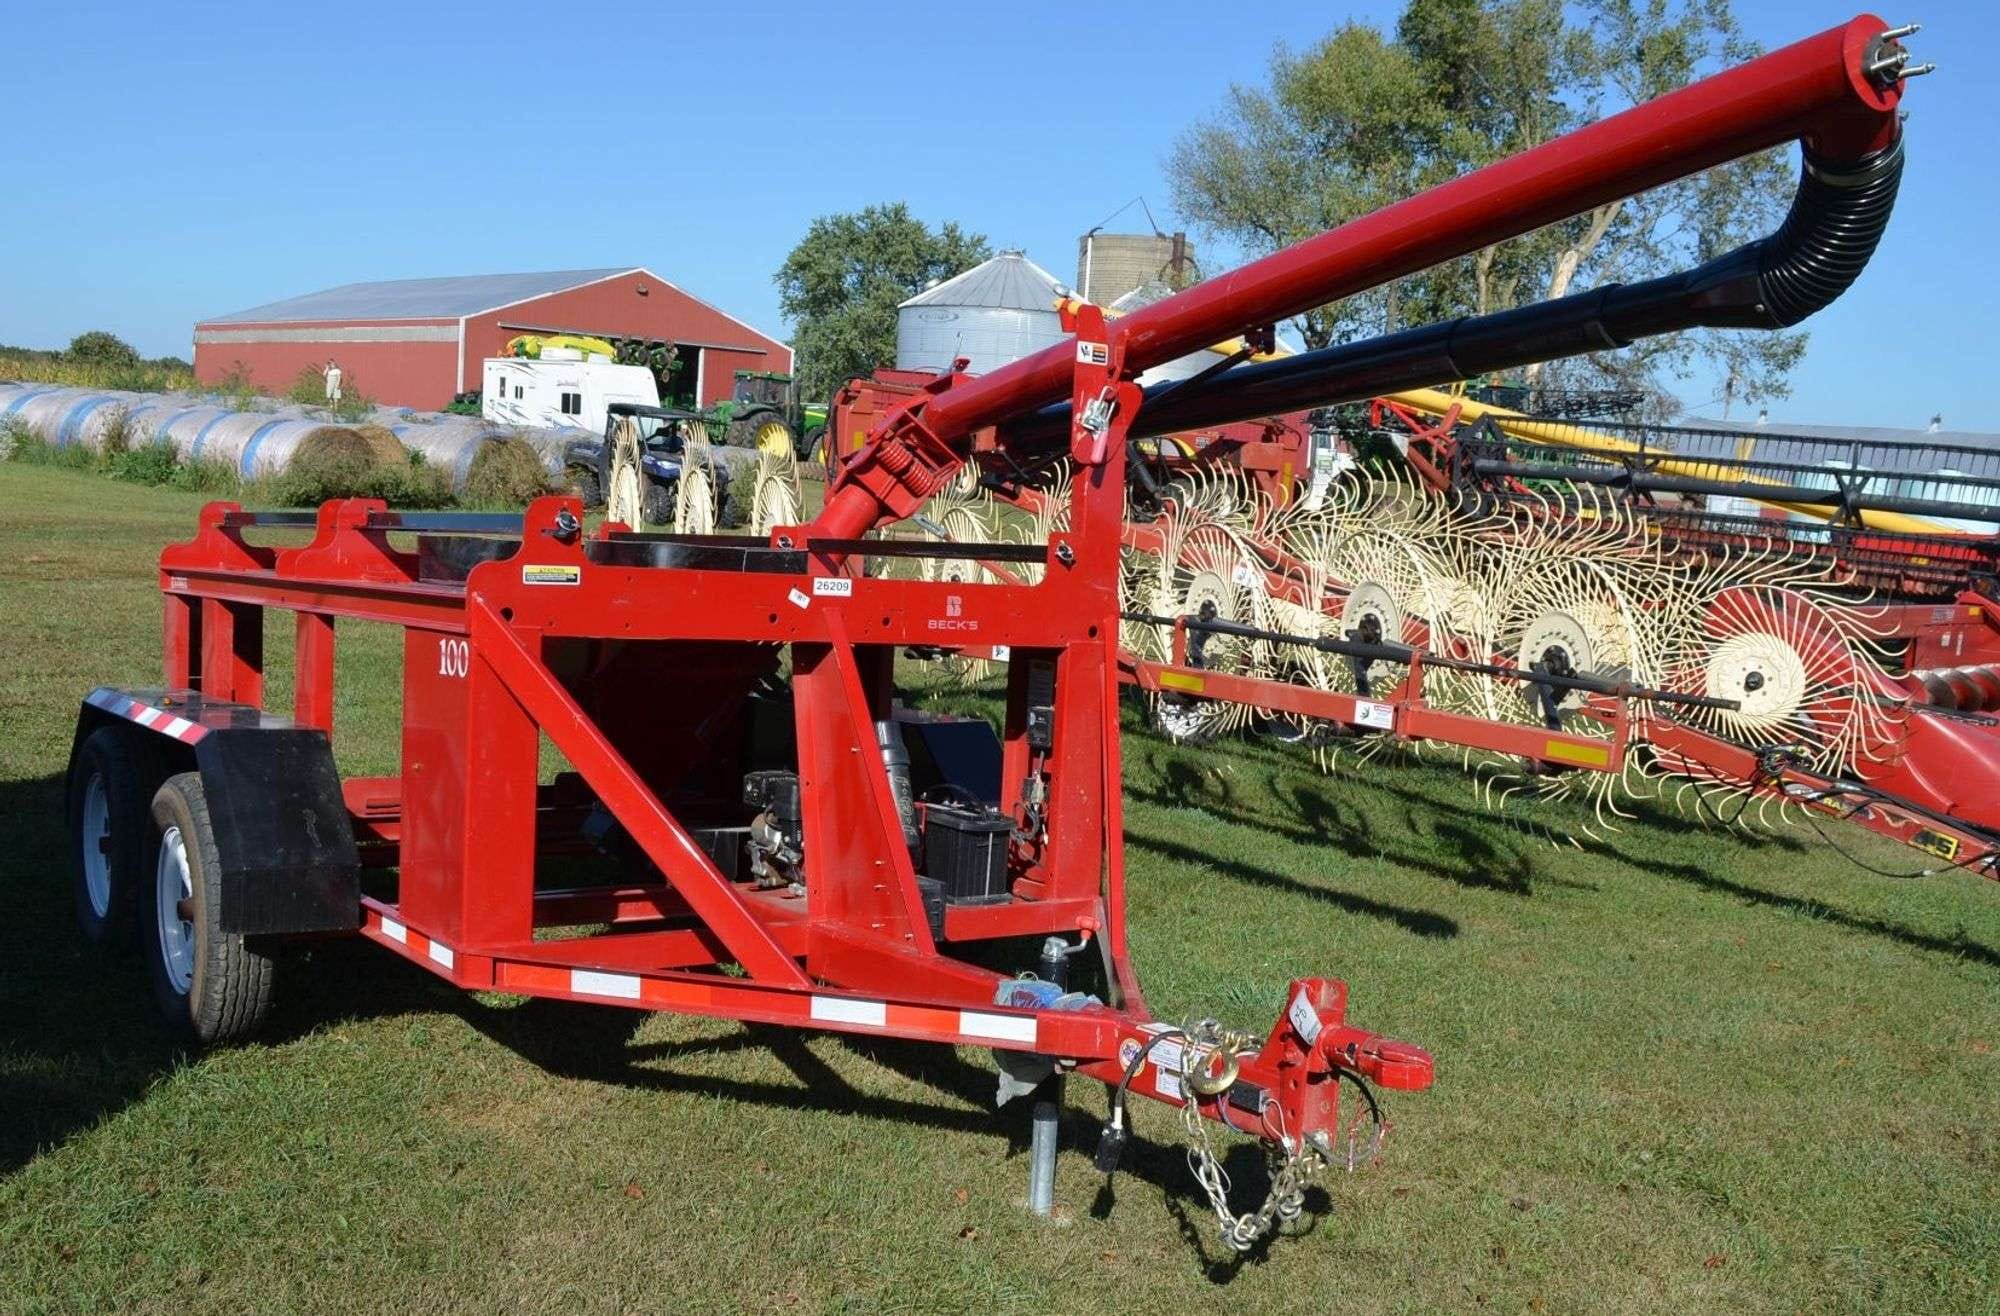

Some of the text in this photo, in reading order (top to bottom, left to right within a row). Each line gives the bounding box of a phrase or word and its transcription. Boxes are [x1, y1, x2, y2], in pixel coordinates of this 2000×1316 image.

[816, 581, 849, 591] 26209
[928, 619, 978, 630] BECK'S
[439, 638, 469, 678] 100
